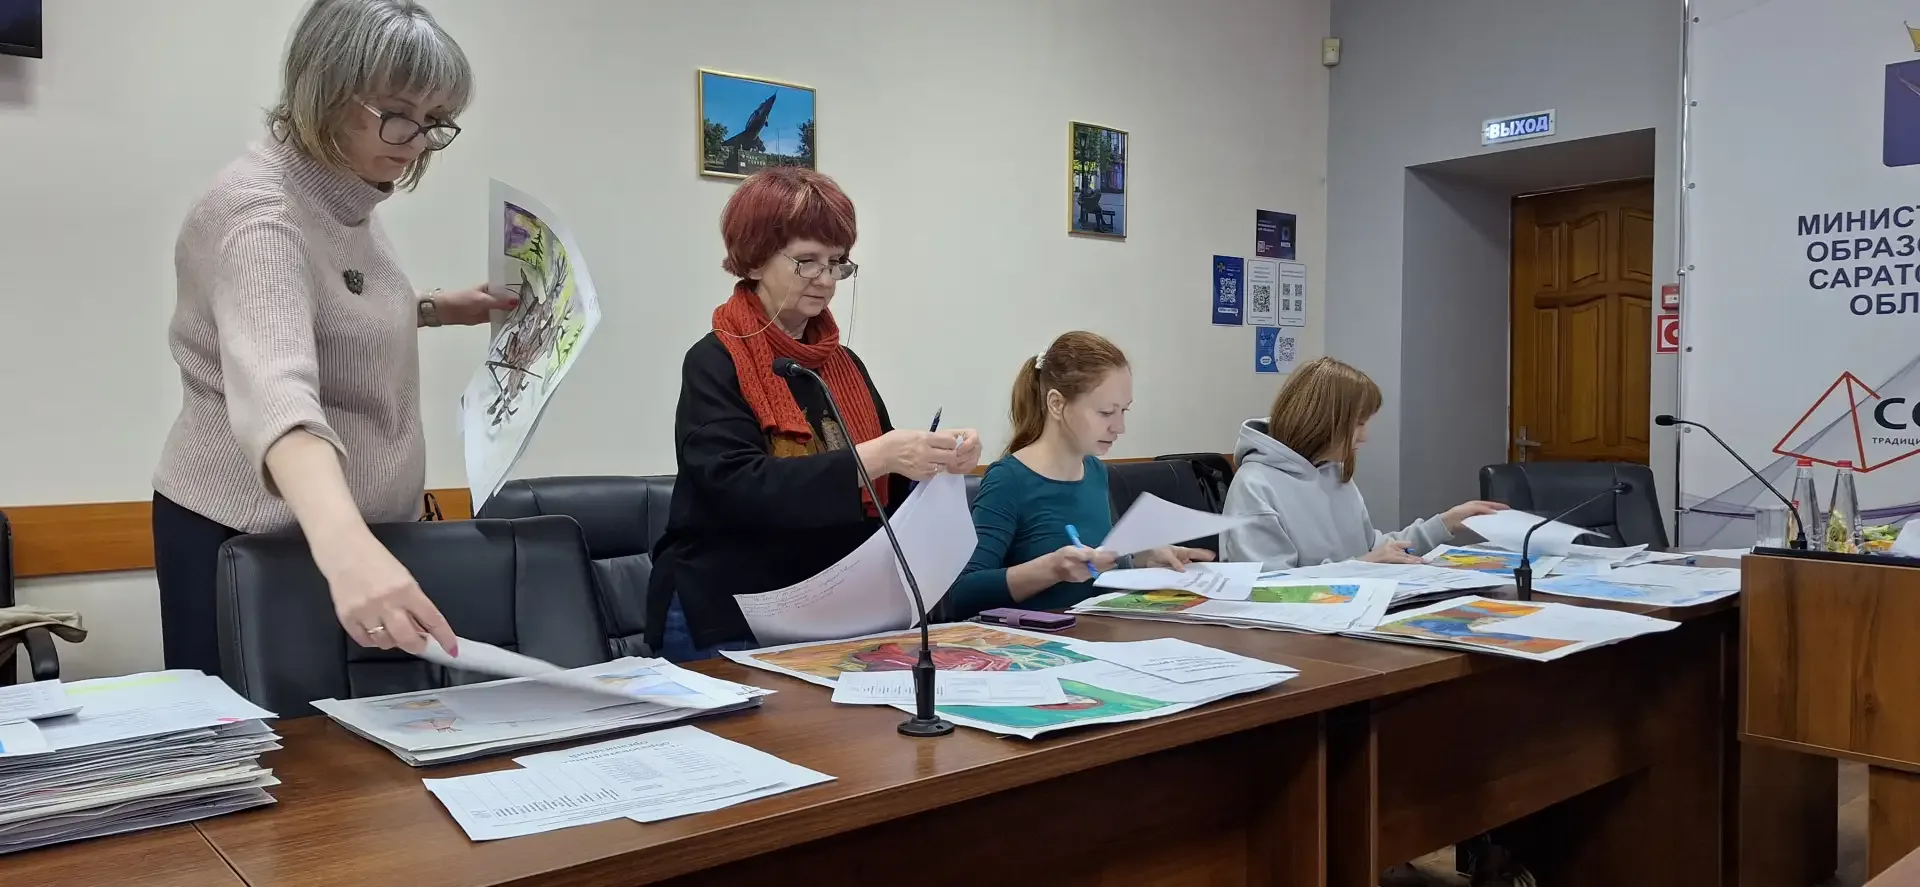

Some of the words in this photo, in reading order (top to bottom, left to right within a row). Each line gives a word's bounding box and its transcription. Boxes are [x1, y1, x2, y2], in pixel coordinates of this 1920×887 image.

[1489, 116, 1548, 139] ВЫХОД
[1798, 205, 1920, 236] МИНИС
[1807, 234, 1920, 262] ОБРАЗ
[1809, 263, 1920, 290] САРАТ
[1874, 397, 1920, 430] С
